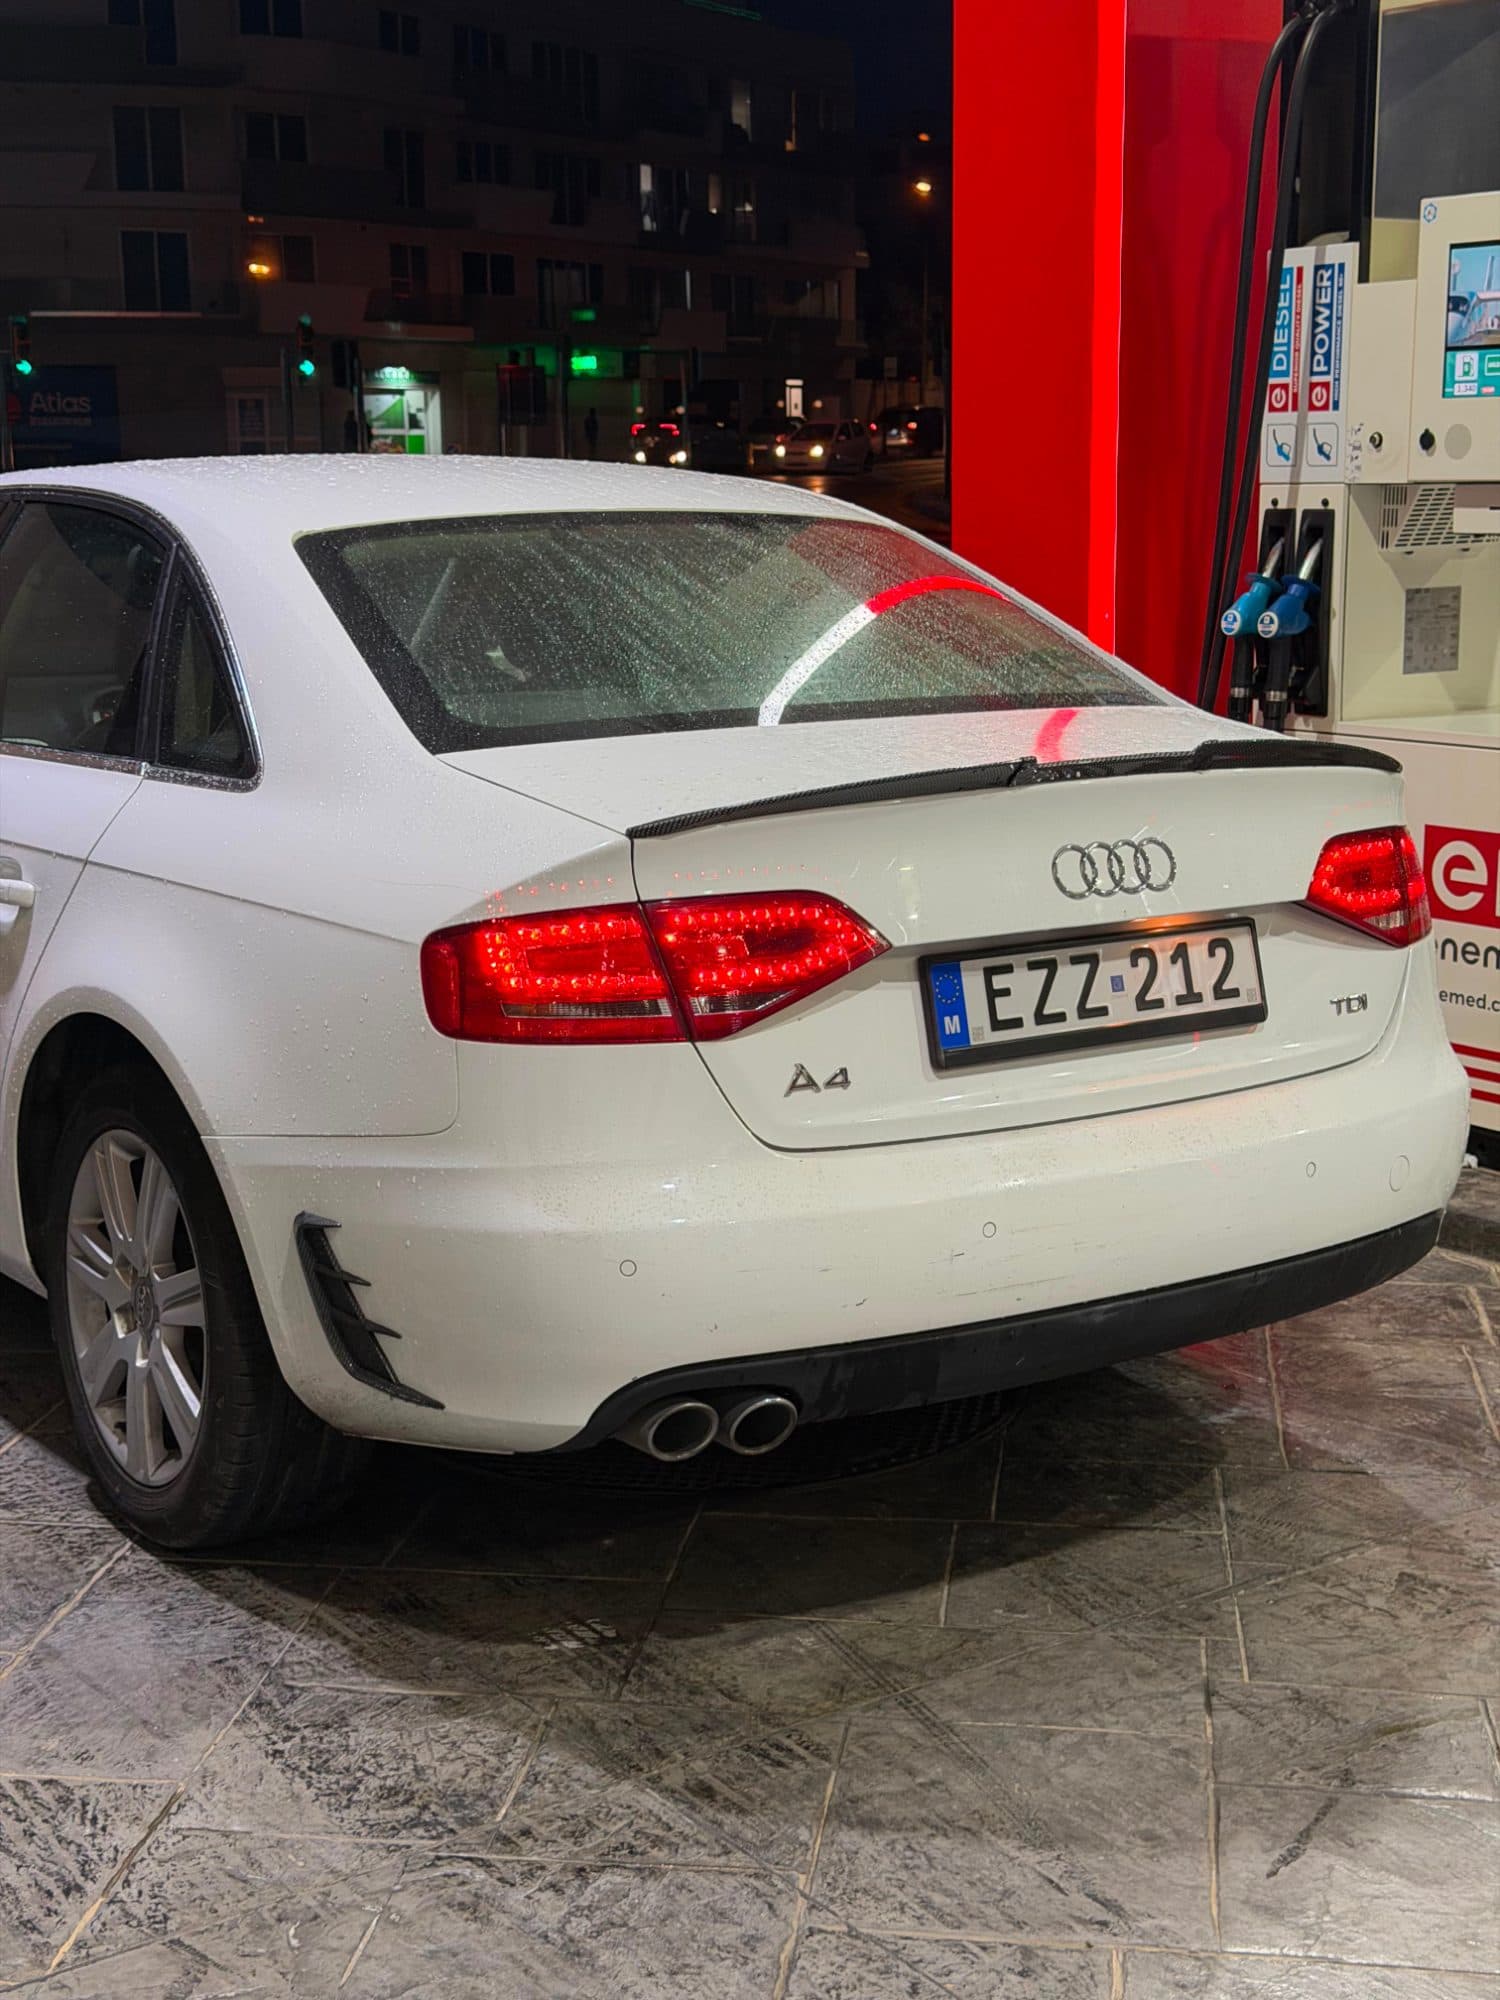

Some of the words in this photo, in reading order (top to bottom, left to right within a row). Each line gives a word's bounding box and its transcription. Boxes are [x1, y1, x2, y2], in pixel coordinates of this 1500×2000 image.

[1294, 314, 1302, 351] QUALITY
[1312, 267, 1333, 373] POWER
[29, 391, 92, 413] Atlas
[944, 1015, 961, 1034] M
[982, 952, 1109, 1032] EZZ
[1129, 937, 1241, 1012] 212
[1329, 993, 1368, 1016] TDI
[783, 1062, 851, 1098] A4
